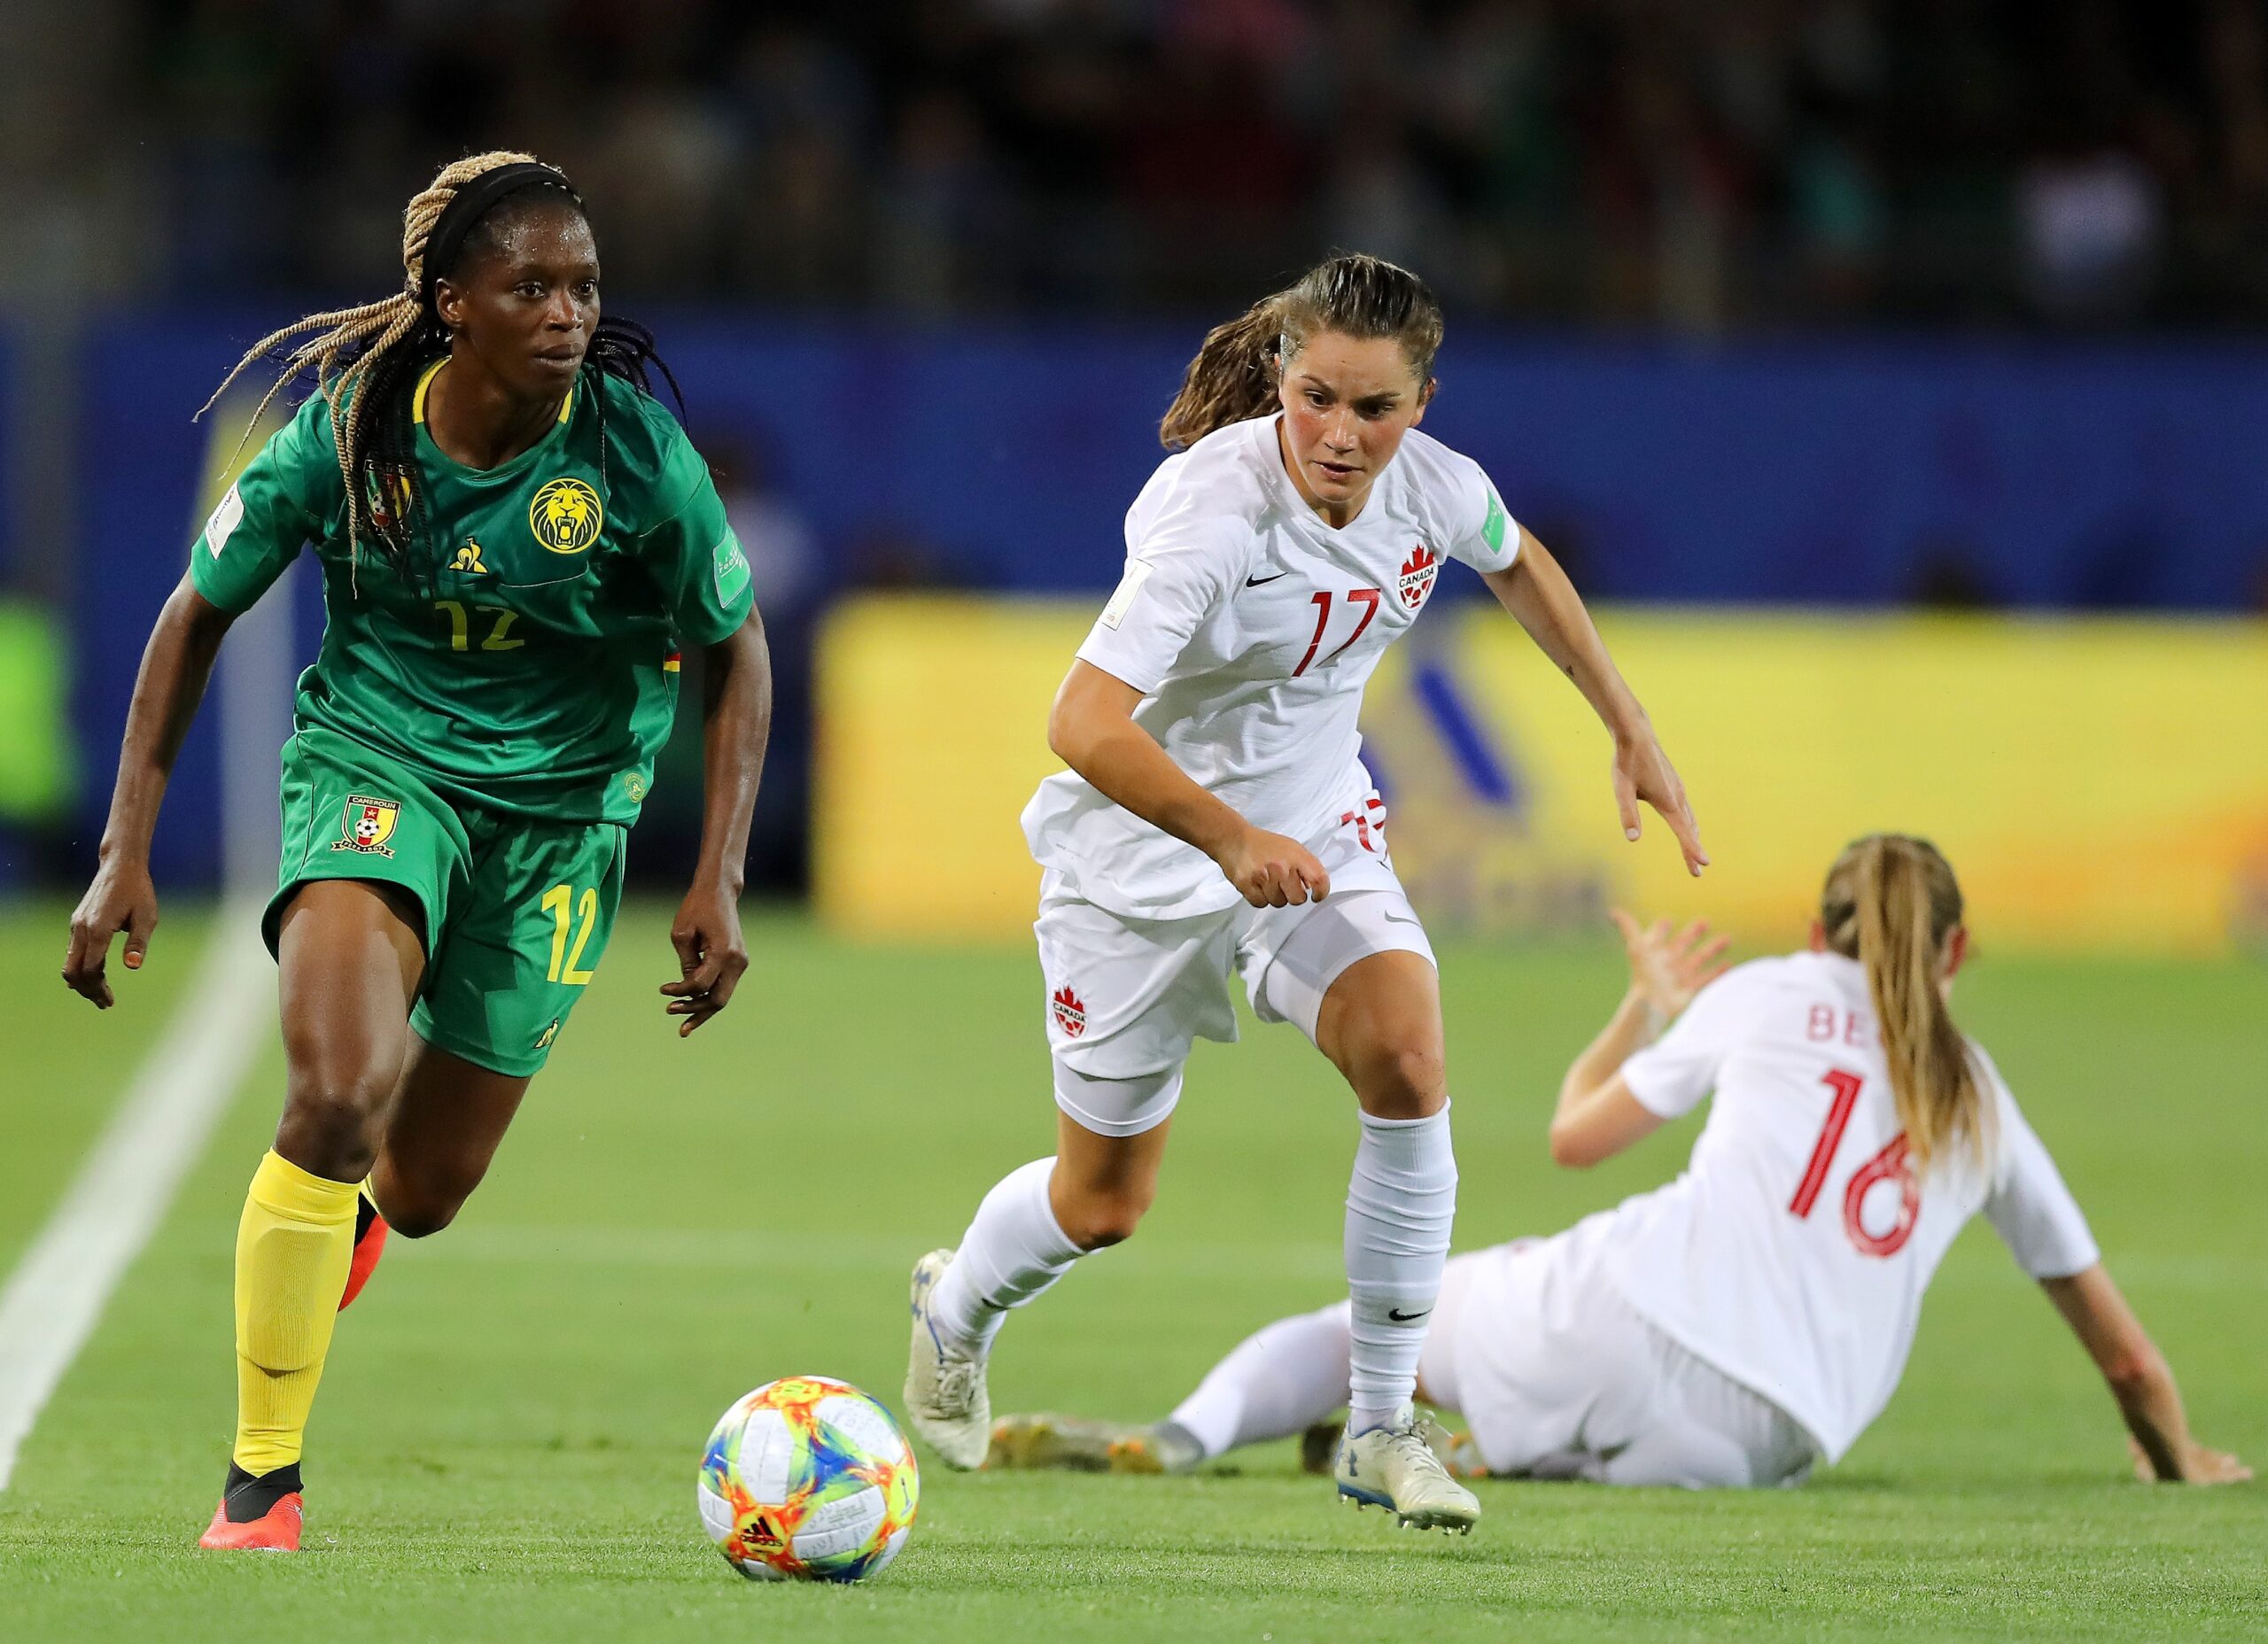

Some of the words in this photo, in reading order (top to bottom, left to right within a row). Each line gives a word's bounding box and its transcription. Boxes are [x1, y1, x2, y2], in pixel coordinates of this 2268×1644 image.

[1399, 567, 1433, 587] CANADA
[435, 601, 524, 650] 12
[1292, 588, 1380, 677] 17
[353, 797, 396, 809] CAMEROUN
[541, 884, 597, 985] 12
[1054, 1002, 1085, 1022] CANADA
[1789, 1069, 1919, 1256] 16
